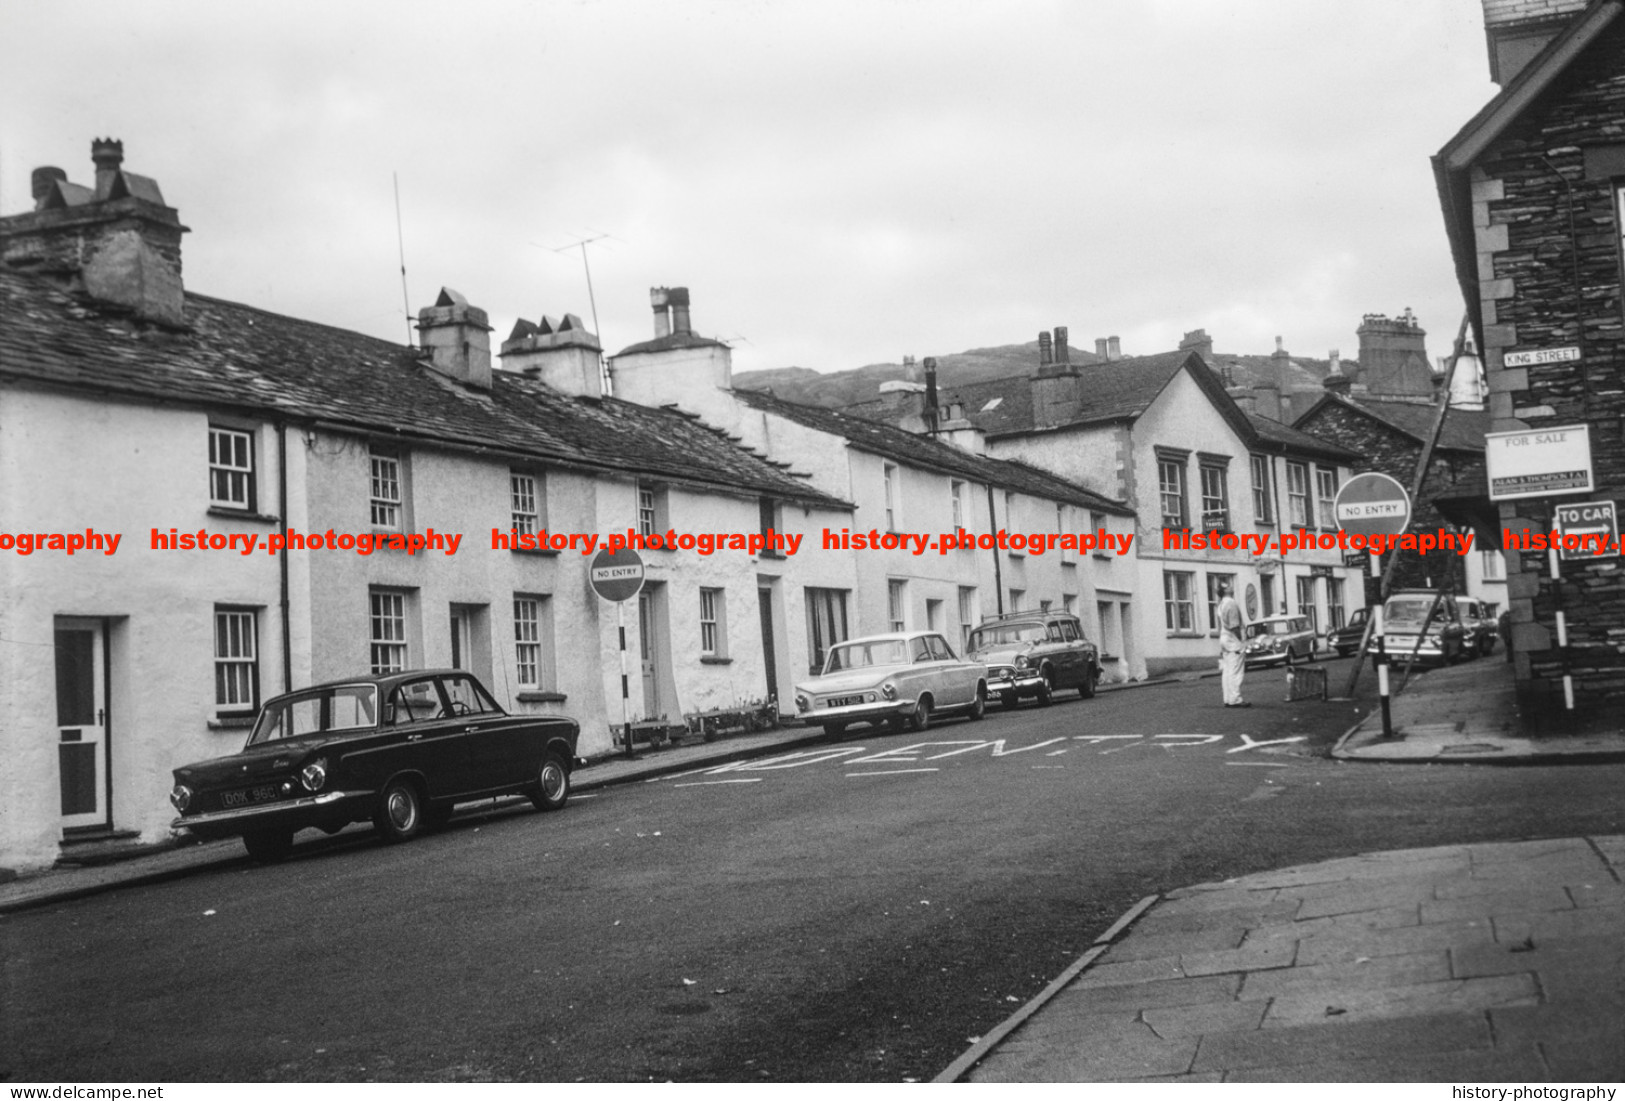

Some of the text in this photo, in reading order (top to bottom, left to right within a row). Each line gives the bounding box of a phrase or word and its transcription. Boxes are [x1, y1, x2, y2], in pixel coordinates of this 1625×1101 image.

[1507, 349, 1577, 365] KING STREET
[1505, 432, 1567, 447] FOR SALE
[1346, 504, 1398, 516] NO ENTRY
[1560, 507, 1612, 523] TO CAR
[597, 568, 637, 578] NO ENTRY
[844, 734, 1309, 764] ENTRY
